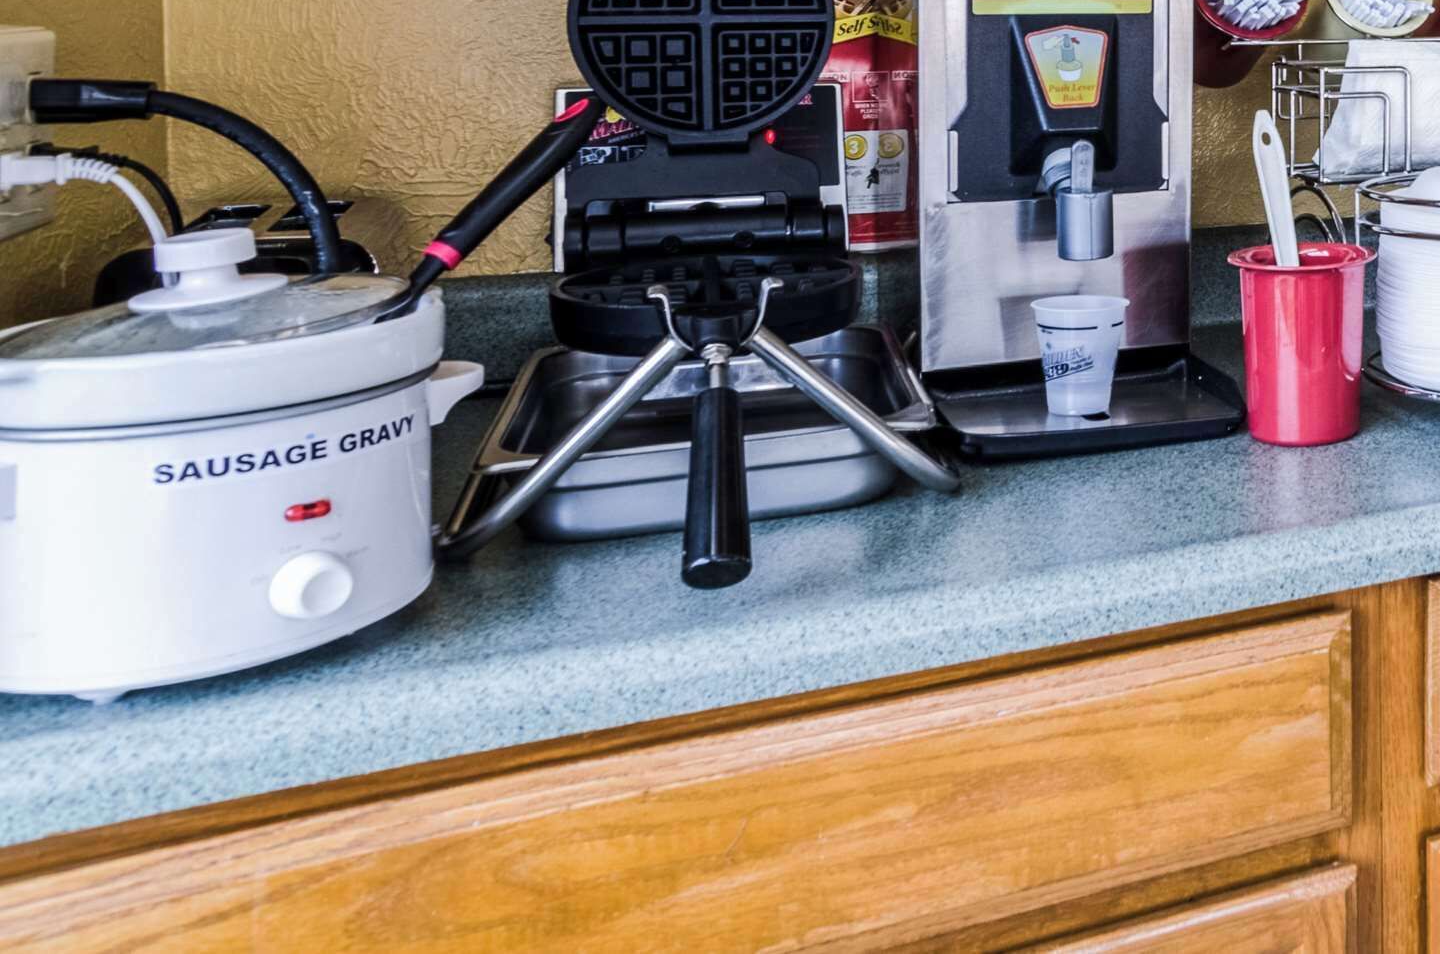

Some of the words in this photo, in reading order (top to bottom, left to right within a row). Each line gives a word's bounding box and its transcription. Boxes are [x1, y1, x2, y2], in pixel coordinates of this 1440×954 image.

[837, 16, 867, 36] Self
[154, 439, 329, 484] SAUSAGE
[339, 414, 415, 454] GRAVY
